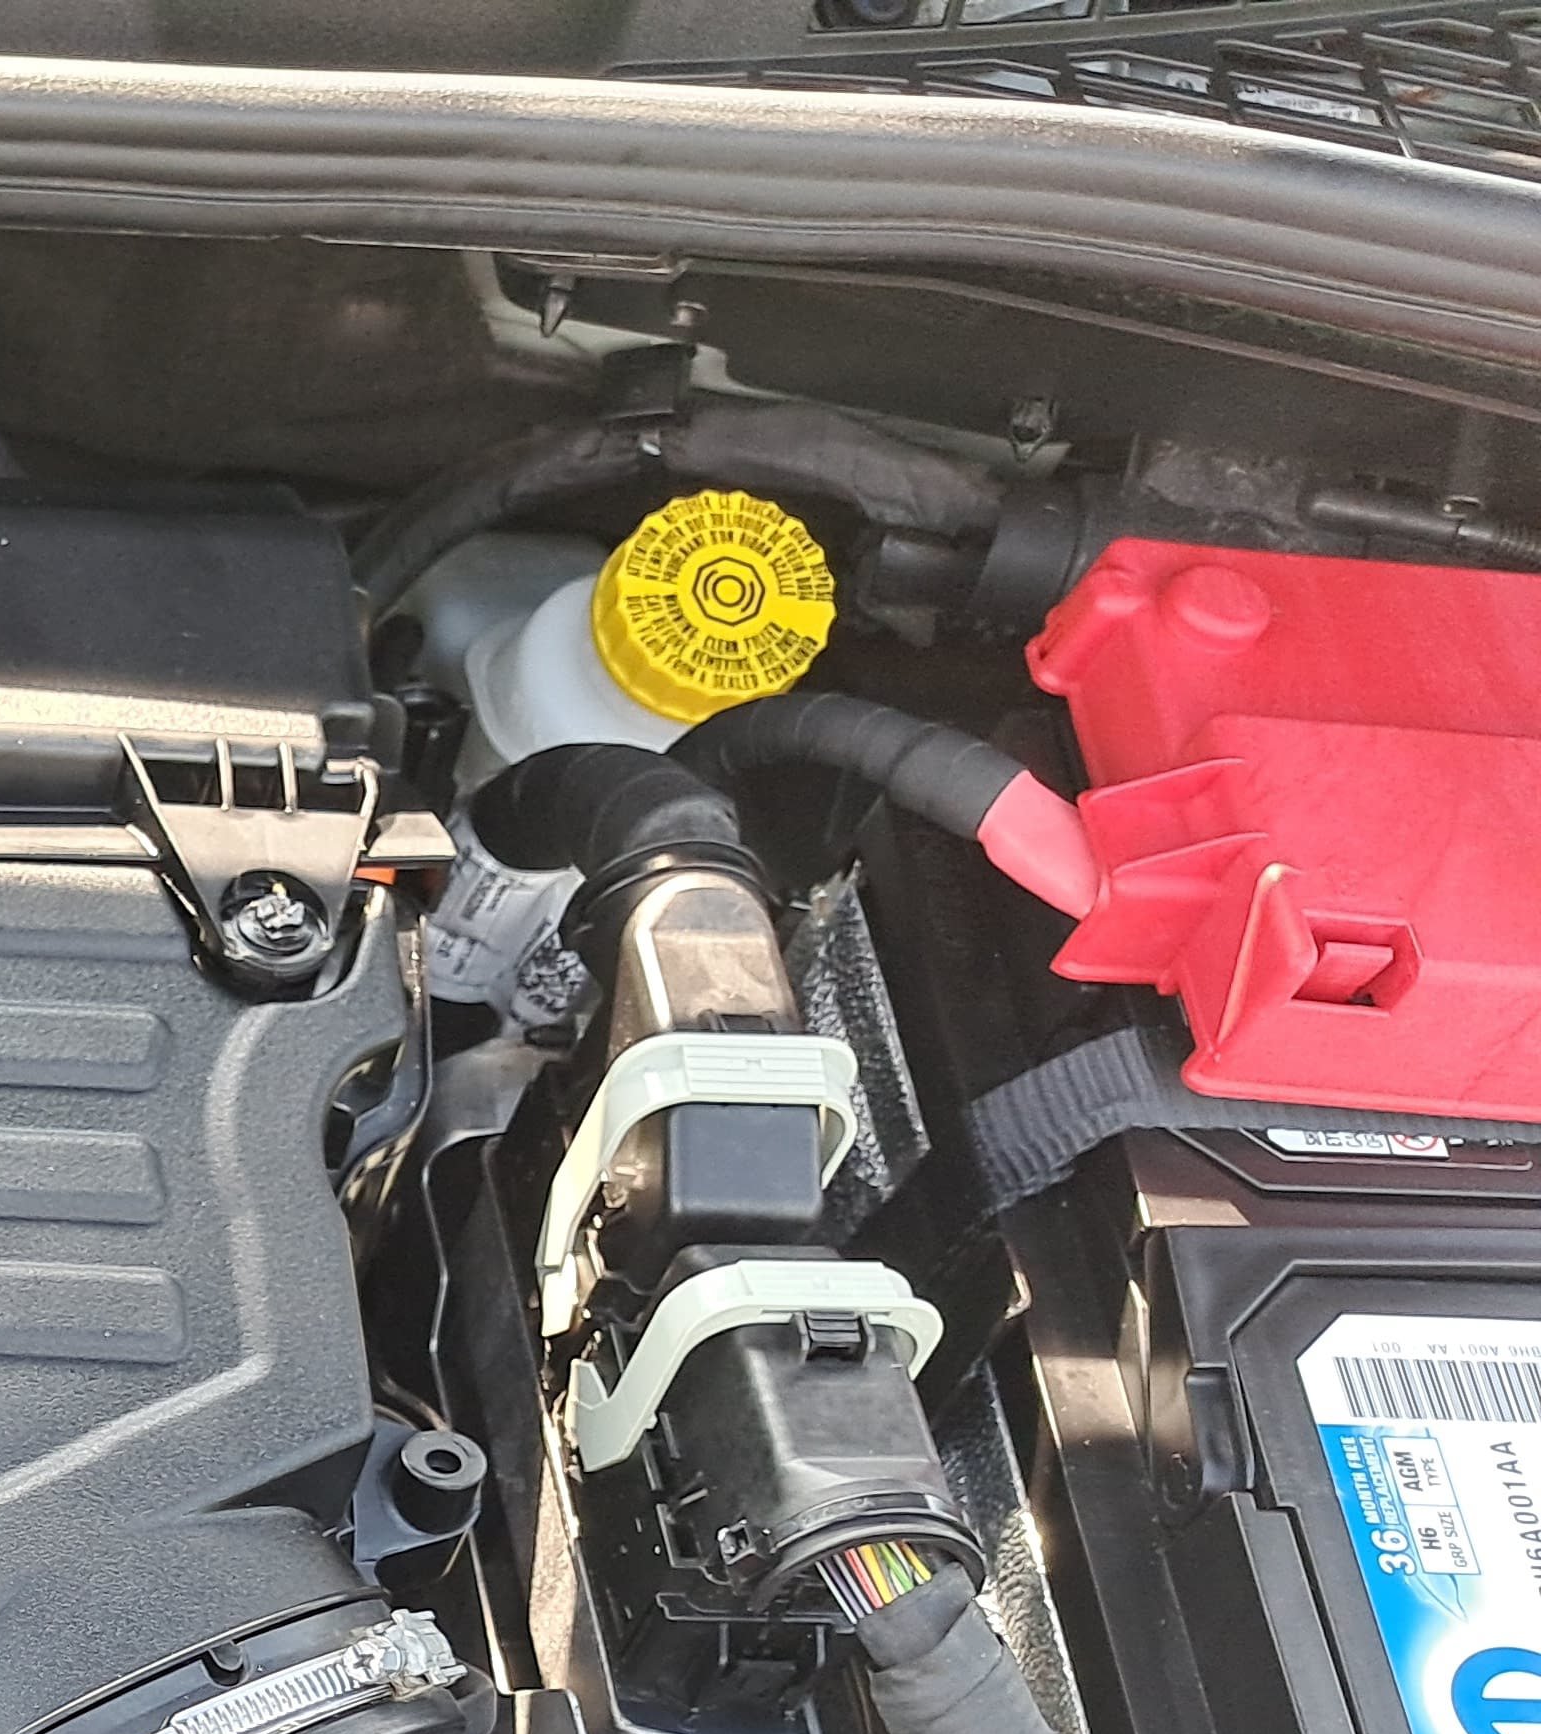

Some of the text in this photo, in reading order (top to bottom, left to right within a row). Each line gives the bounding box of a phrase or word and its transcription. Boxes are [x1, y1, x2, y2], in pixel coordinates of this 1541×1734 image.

[1340, 1436, 1381, 1525] MONTH FREE
[1359, 1436, 1401, 1526] REPLACEMENT
[1392, 1451, 1424, 1492] AGM
[1420, 1457, 1442, 1487] TYPE
[1370, 1528, 1417, 1576] 36
[1418, 1526, 1442, 1550] H6
[1438, 1511, 1468, 1568] GRP SIZE
